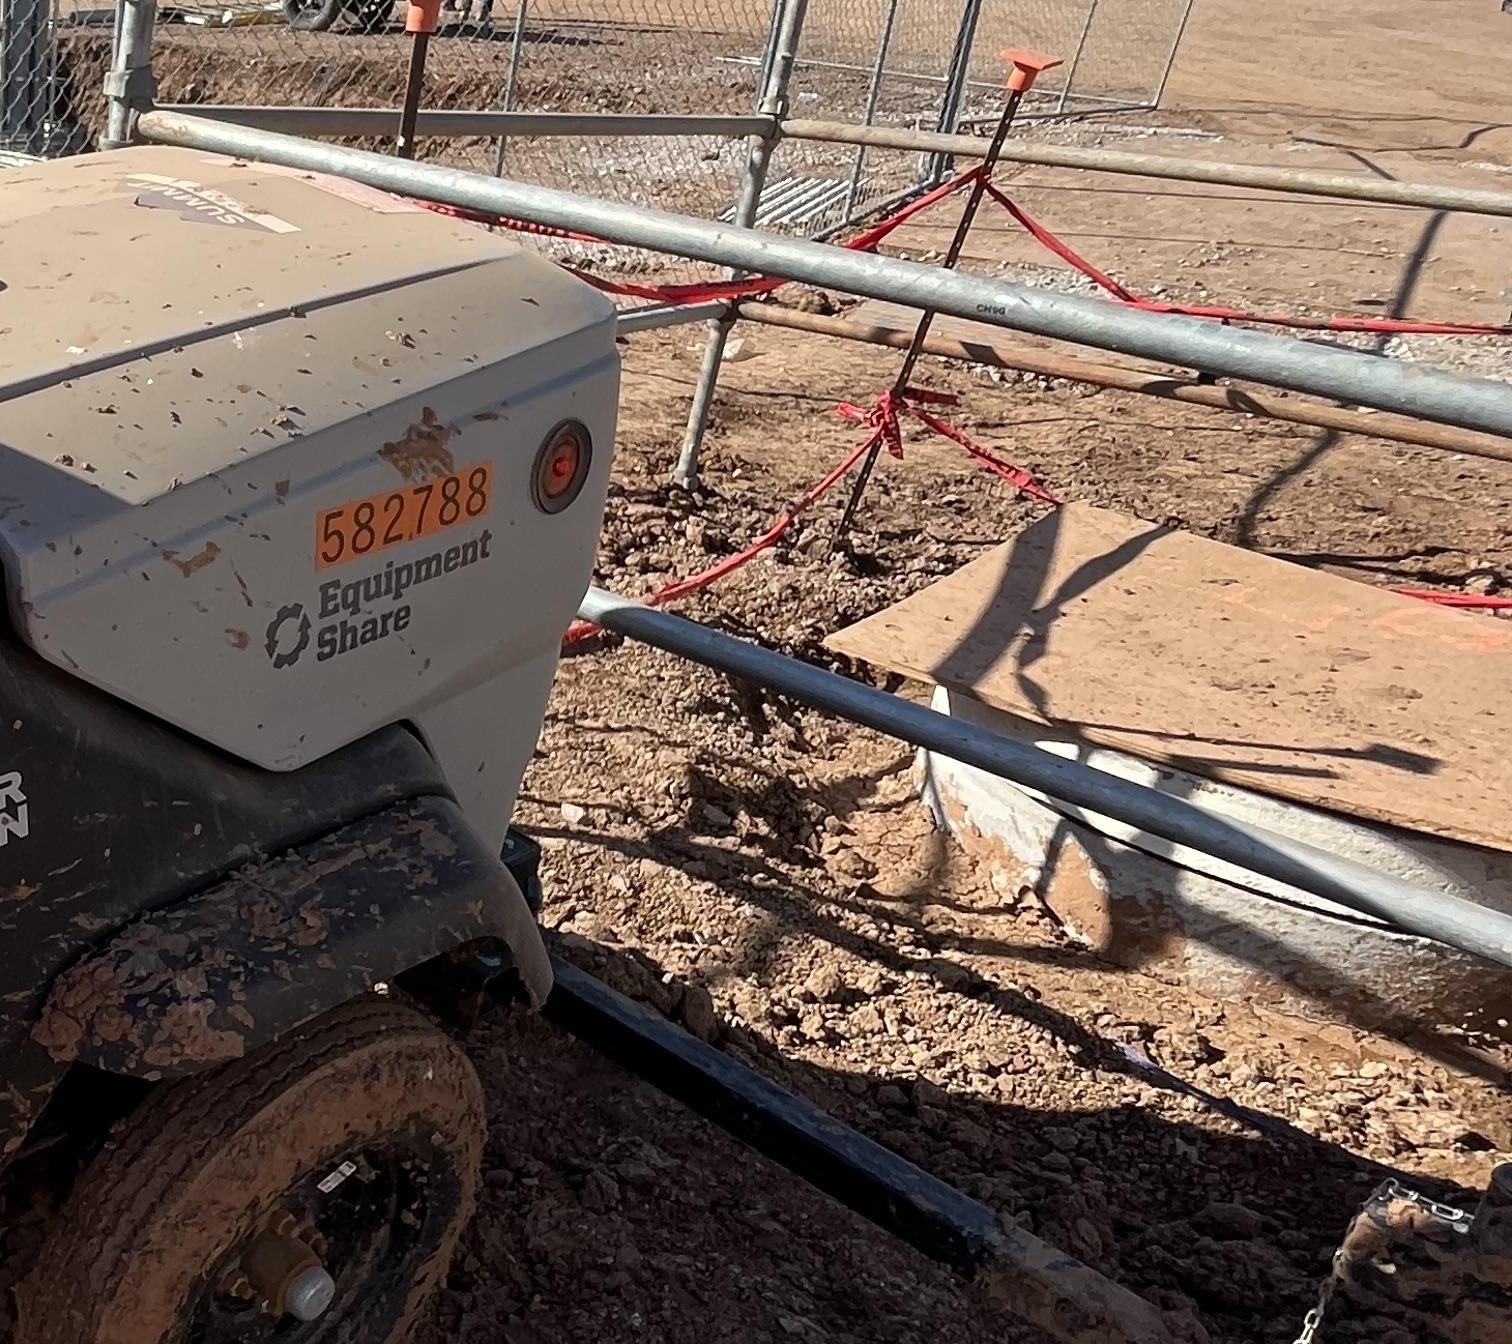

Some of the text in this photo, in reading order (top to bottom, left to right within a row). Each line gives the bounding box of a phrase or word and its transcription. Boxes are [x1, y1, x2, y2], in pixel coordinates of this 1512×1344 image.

[321, 467, 488, 564] 582788
[318, 529, 492, 620] Equipment
[316, 604, 412, 662] Share
